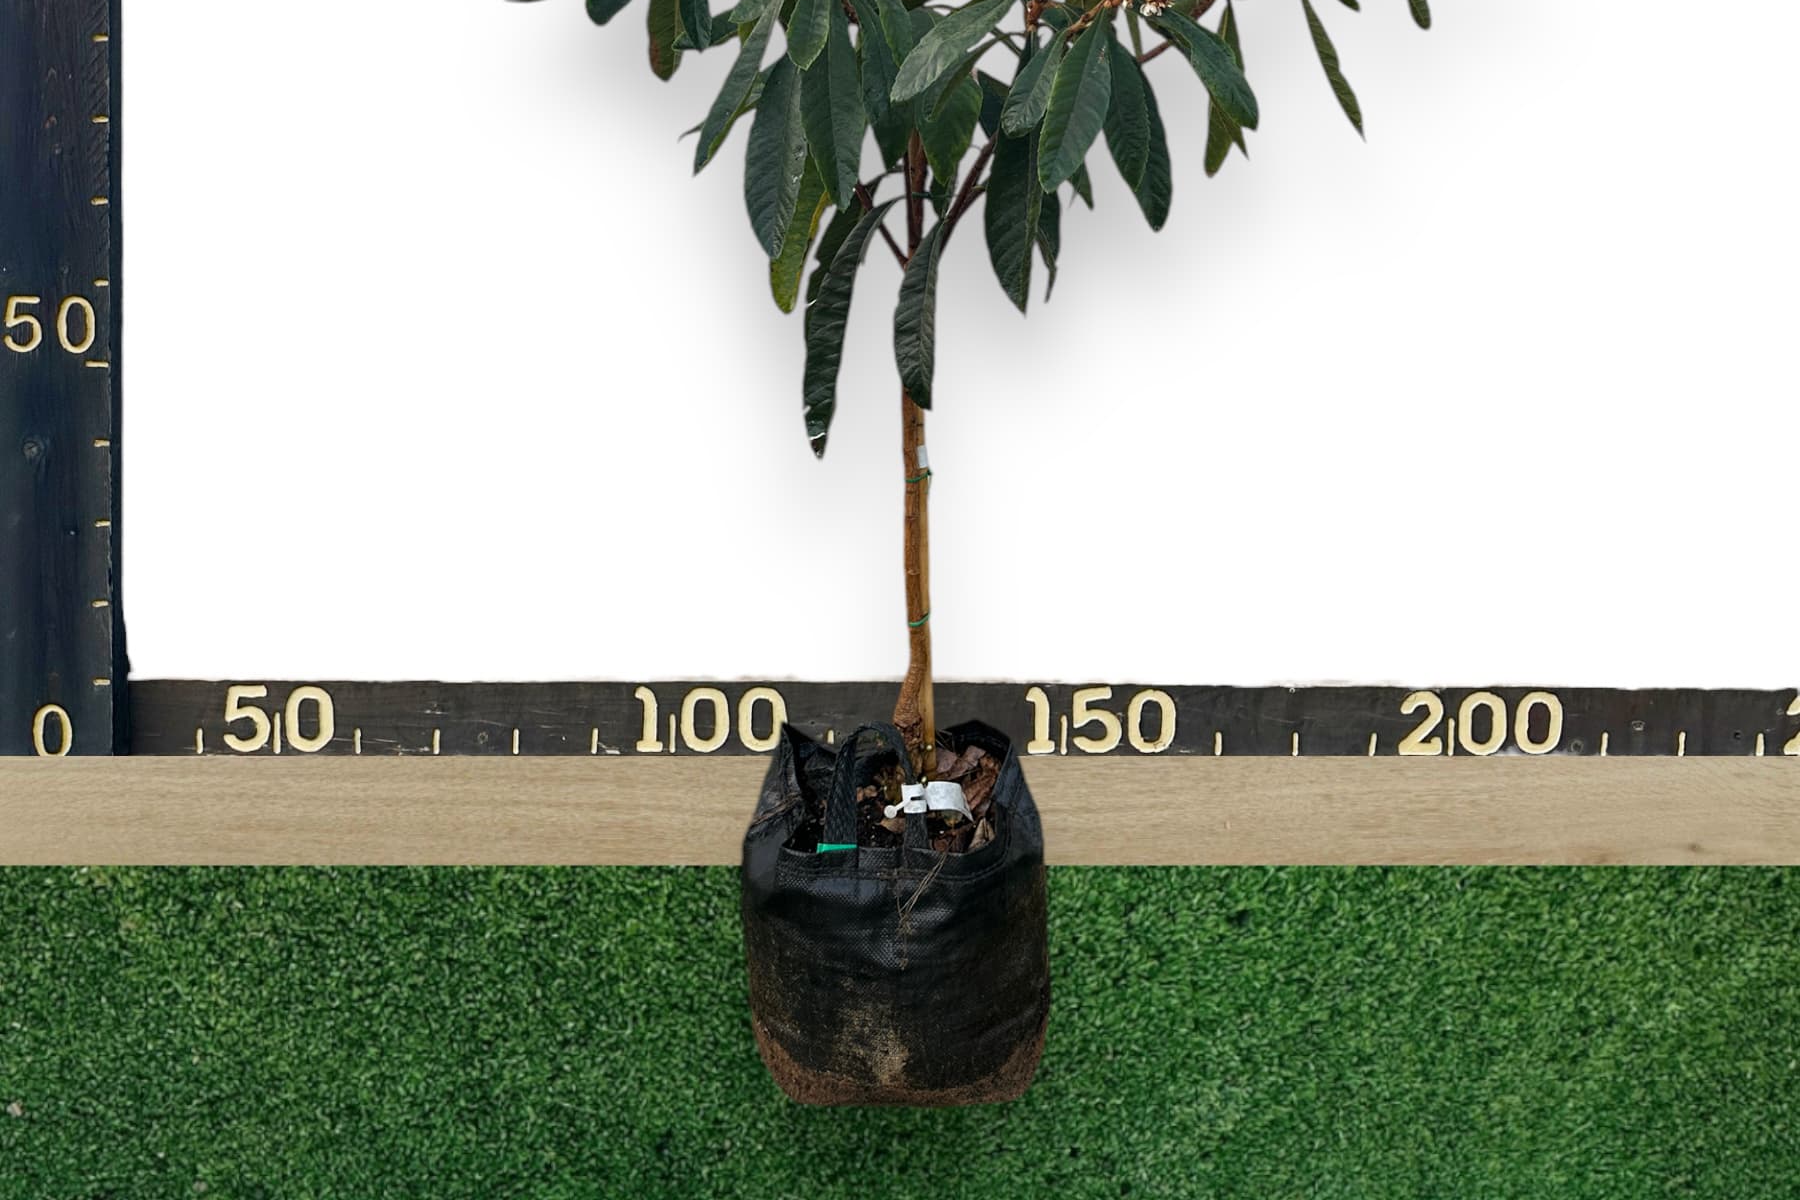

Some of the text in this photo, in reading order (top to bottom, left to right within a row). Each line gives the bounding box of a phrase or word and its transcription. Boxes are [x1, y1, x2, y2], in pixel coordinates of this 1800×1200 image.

[4, 295, 96, 354] 50
[32, 704, 73, 757] 0
[223, 684, 335, 752] 50
[634, 686, 789, 753] 100
[1025, 686, 1177, 754] 150
[1398, 690, 1564, 755] 200
